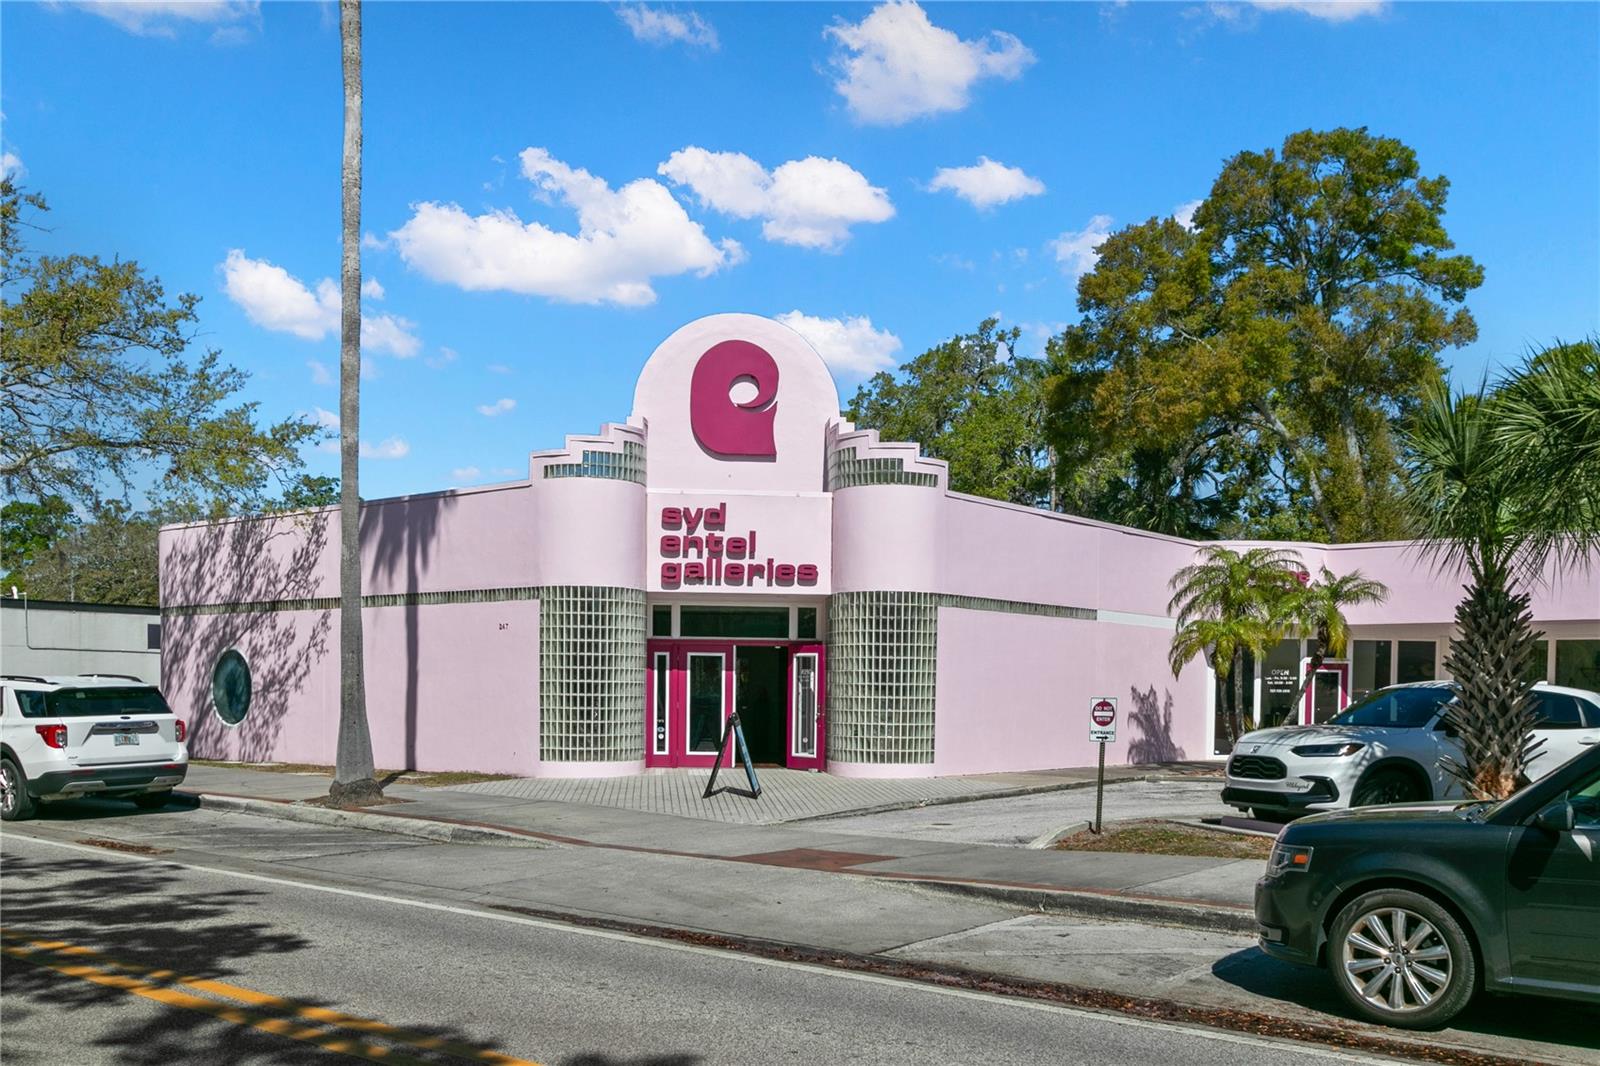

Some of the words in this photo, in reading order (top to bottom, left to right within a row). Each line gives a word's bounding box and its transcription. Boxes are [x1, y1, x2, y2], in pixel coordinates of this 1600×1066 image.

[661, 502, 726, 535] syd
[660, 531, 756, 560] entel
[661, 557, 819, 590] galleries
